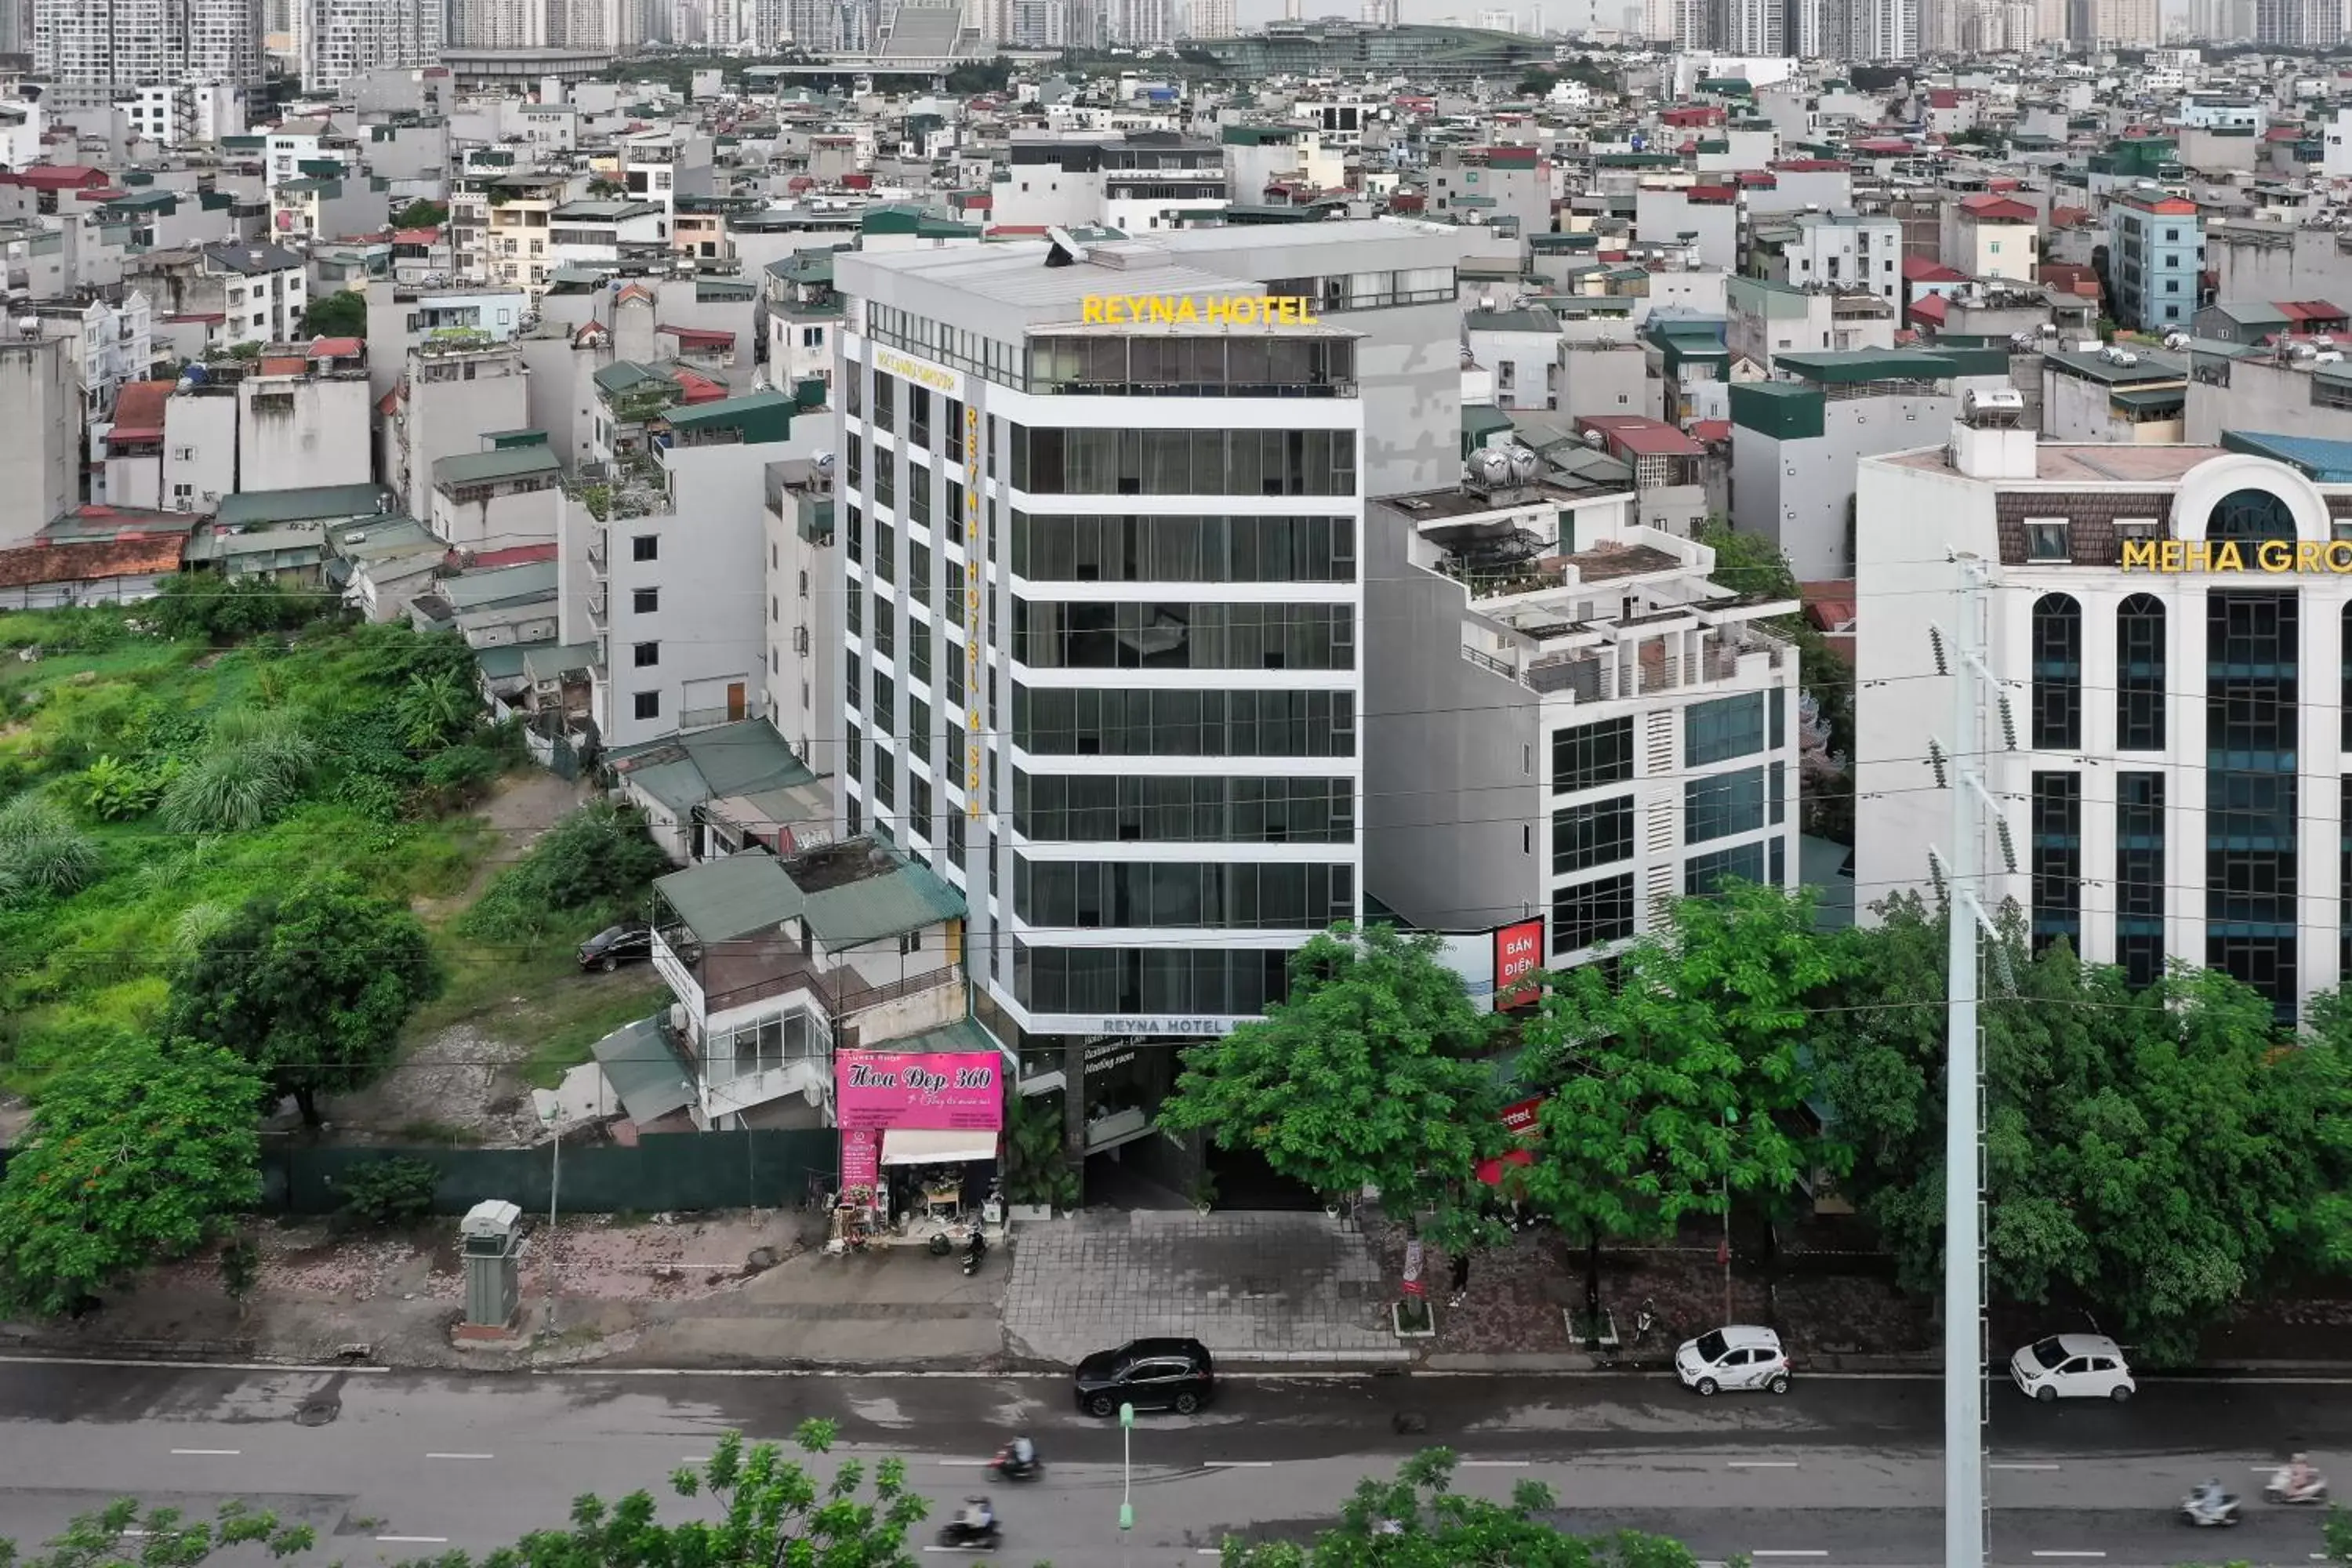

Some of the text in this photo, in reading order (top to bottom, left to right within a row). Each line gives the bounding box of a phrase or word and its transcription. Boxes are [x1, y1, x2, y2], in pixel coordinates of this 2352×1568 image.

[1083, 294, 1317, 325] REYNA HOTEL
[967, 406, 978, 540] REYNA
[2122, 539, 2352, 573] MEHA GRO
[968, 560, 979, 693] HOTEL
[970, 745, 980, 820] SPA
[1506, 936, 1533, 955] BÁN
[1102, 1020, 1160, 1033] REYNA
[1167, 1020, 1225, 1033] HOTEL
[848, 1062, 993, 1094] Hoa Đẹp 360
